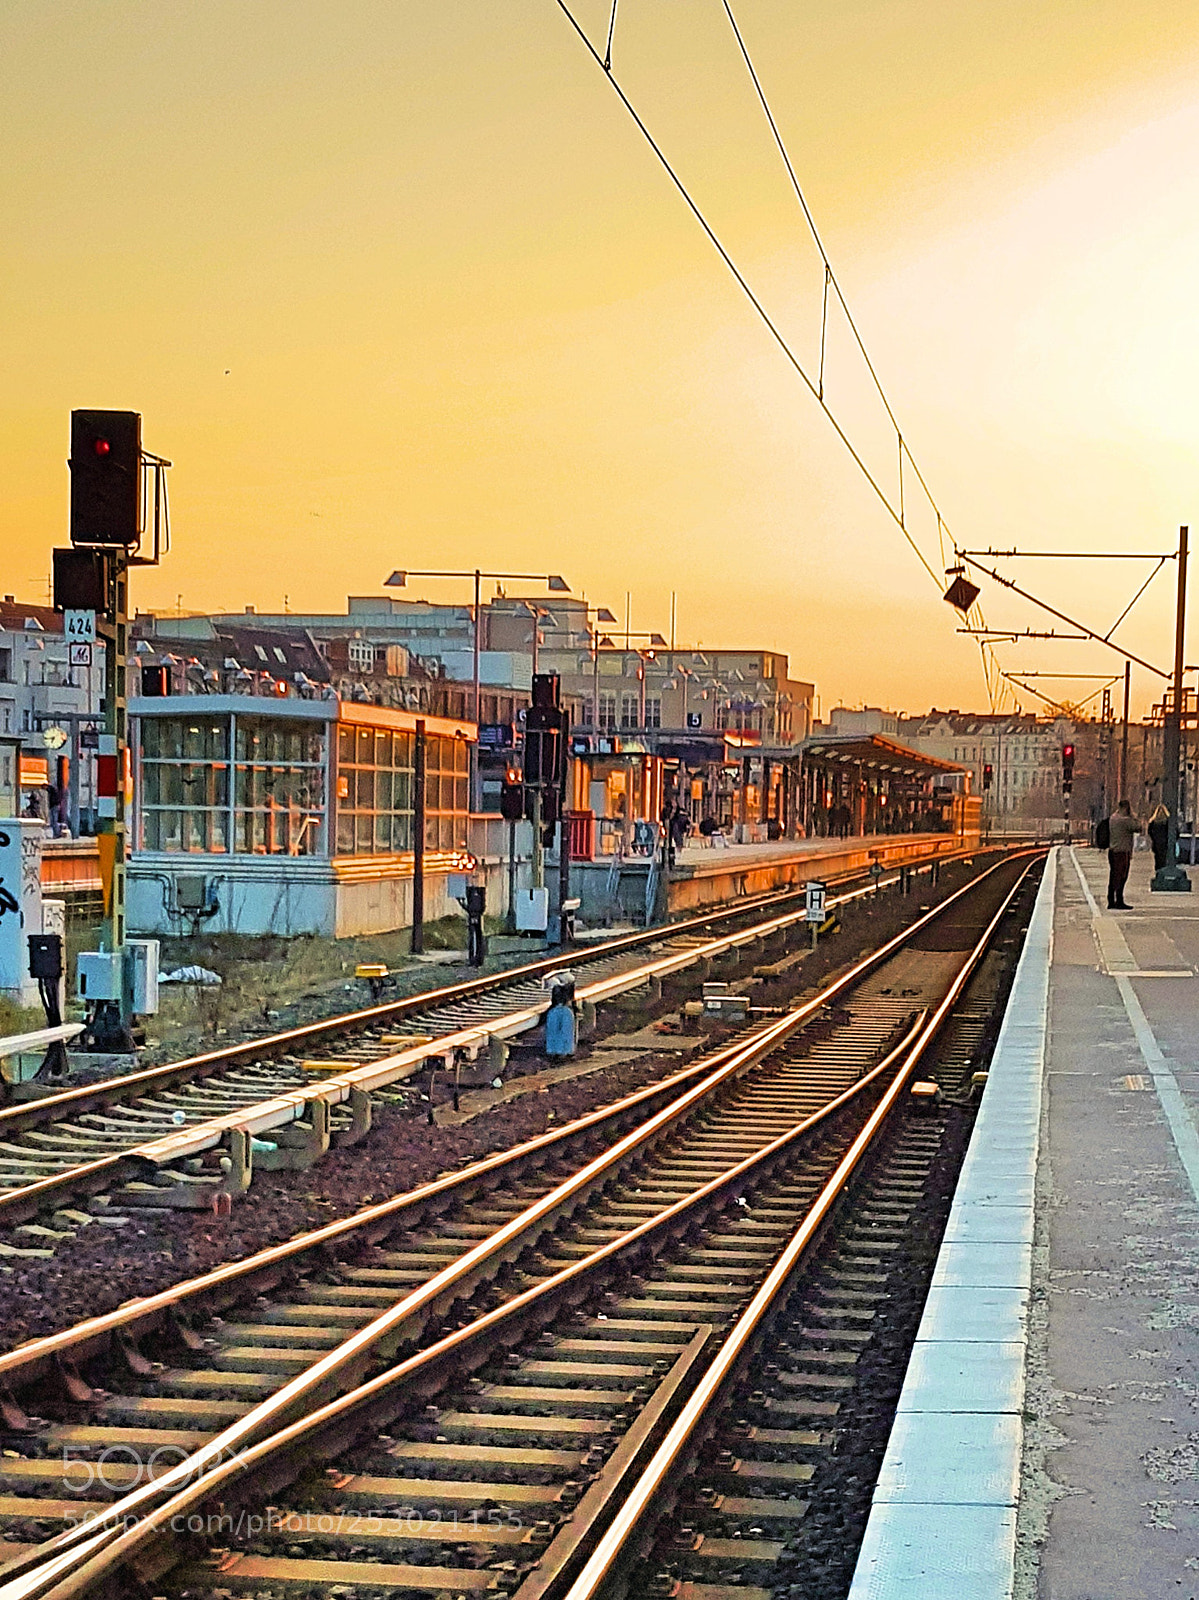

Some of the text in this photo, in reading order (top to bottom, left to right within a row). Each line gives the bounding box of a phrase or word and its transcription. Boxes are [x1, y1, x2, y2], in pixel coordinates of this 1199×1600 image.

[69, 617, 92, 635] 424
[692, 712, 700, 726] 5
[810, 890, 822, 909] H
